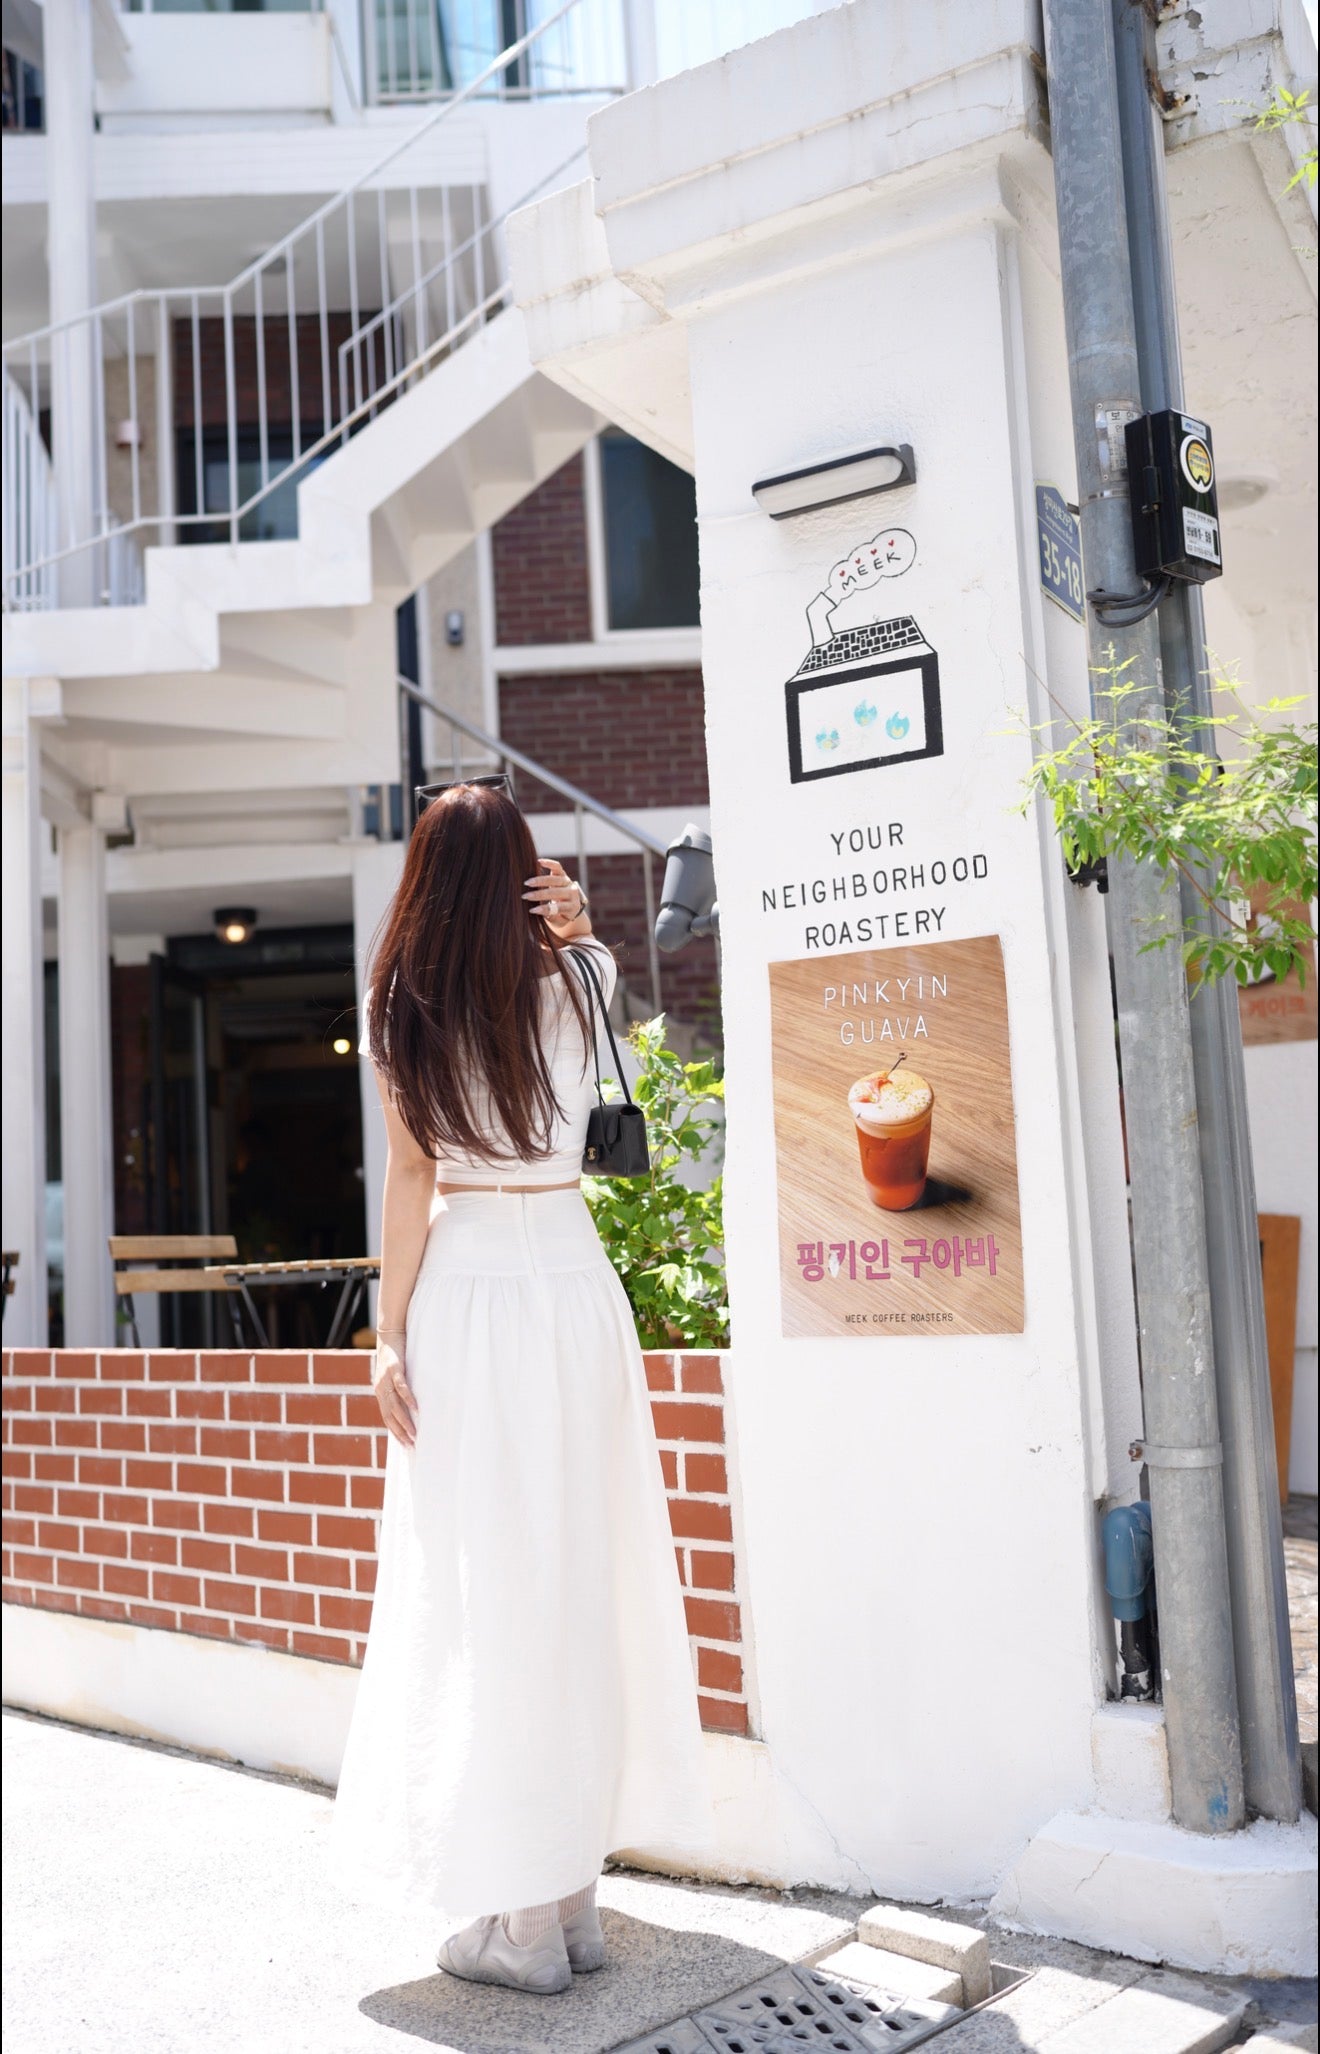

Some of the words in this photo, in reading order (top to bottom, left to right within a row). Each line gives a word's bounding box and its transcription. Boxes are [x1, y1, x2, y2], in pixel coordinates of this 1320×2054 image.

[842, 552, 901, 590] MEEK
[1042, 532, 1081, 604] 35-18
[830, 823, 904, 856] YOUR
[762, 854, 988, 911] NEIGHBORHOOD
[805, 907, 946, 949] ROASTERY
[823, 974, 949, 1009] PINKYIN
[840, 1014, 929, 1046] GUAVA
[901, 1234, 1000, 1279] 구아바
[845, 1314, 868, 1324] MEEK
[872, 1313, 906, 1323] COFFEE
[911, 1312, 954, 1322] ROASTERS
